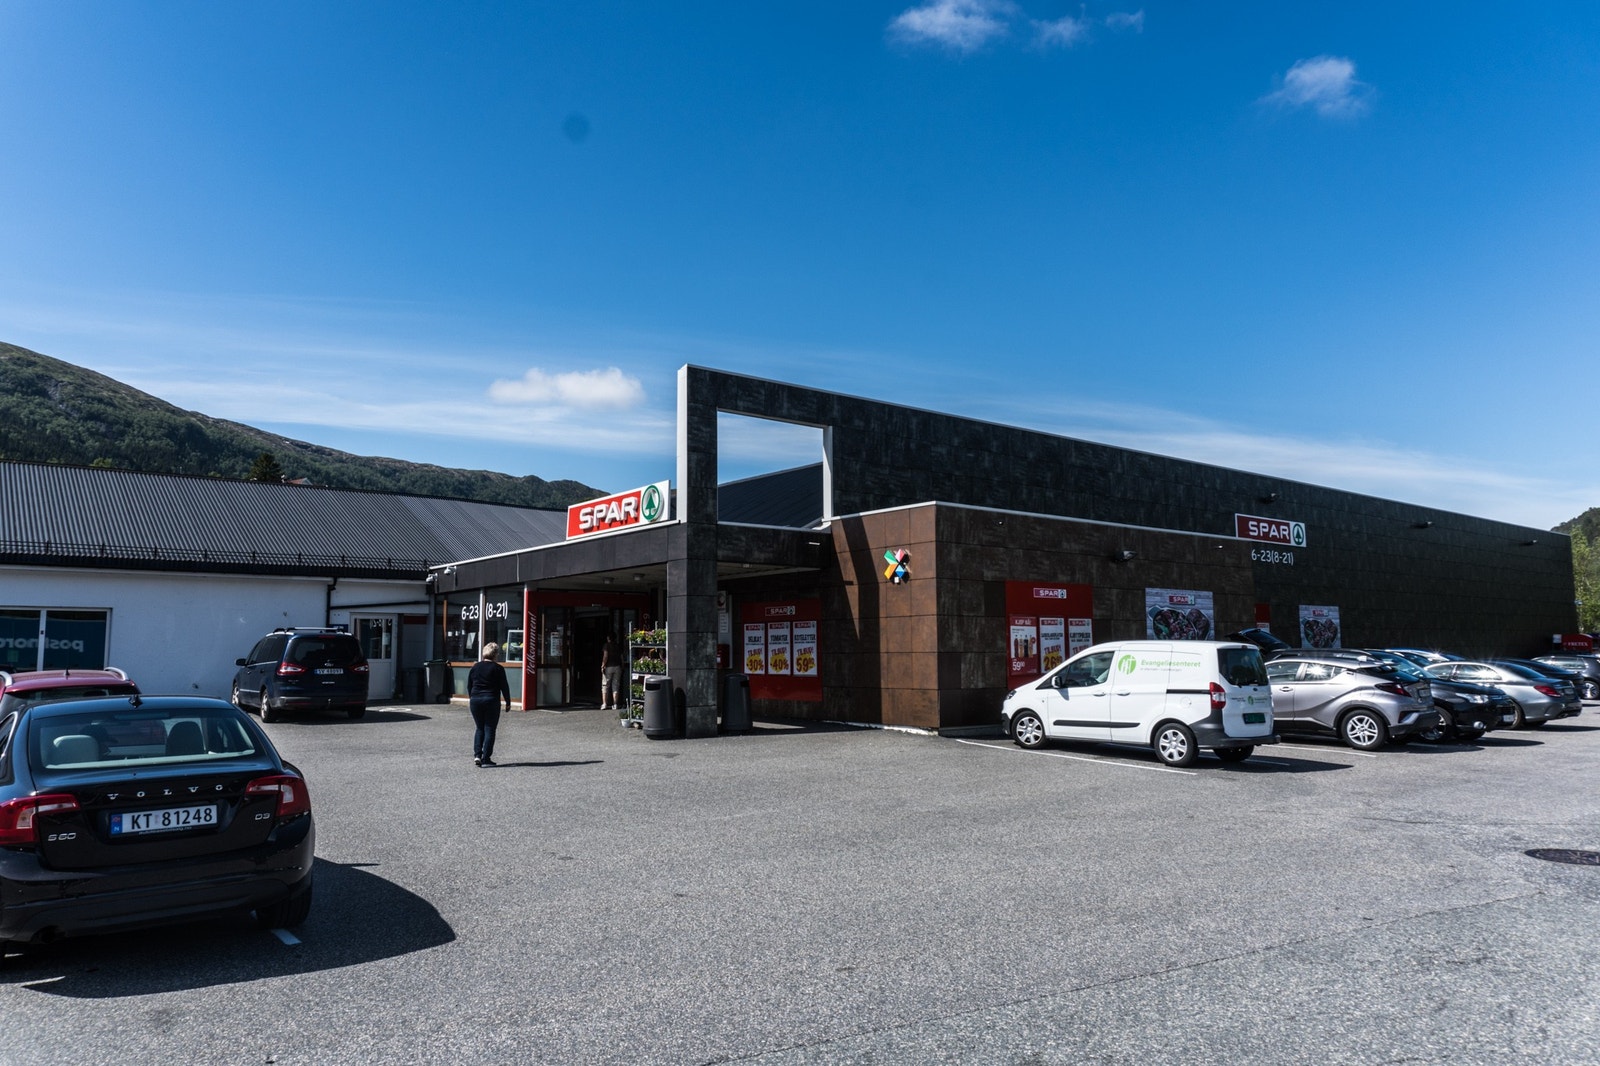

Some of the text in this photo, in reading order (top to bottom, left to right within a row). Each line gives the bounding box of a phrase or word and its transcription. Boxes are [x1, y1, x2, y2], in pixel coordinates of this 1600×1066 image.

[579, 496, 637, 530] SPAR
[1248, 520, 1290, 540] SPAR
[1251, 548, 1294, 566] 6-23(8-21)
[1039, 589, 1058, 597] SPAR
[461, 601, 509, 620] 6-23 (8-21)
[770, 606, 787, 615] SPAR
[527, 610, 538, 676] Velkommen!
[1141, 659, 1201, 668] Evangeliesenteret
[107, 784, 223, 800] VOLVO
[131, 807, 213, 830] KT 81248
[254, 812, 271, 821] D3
